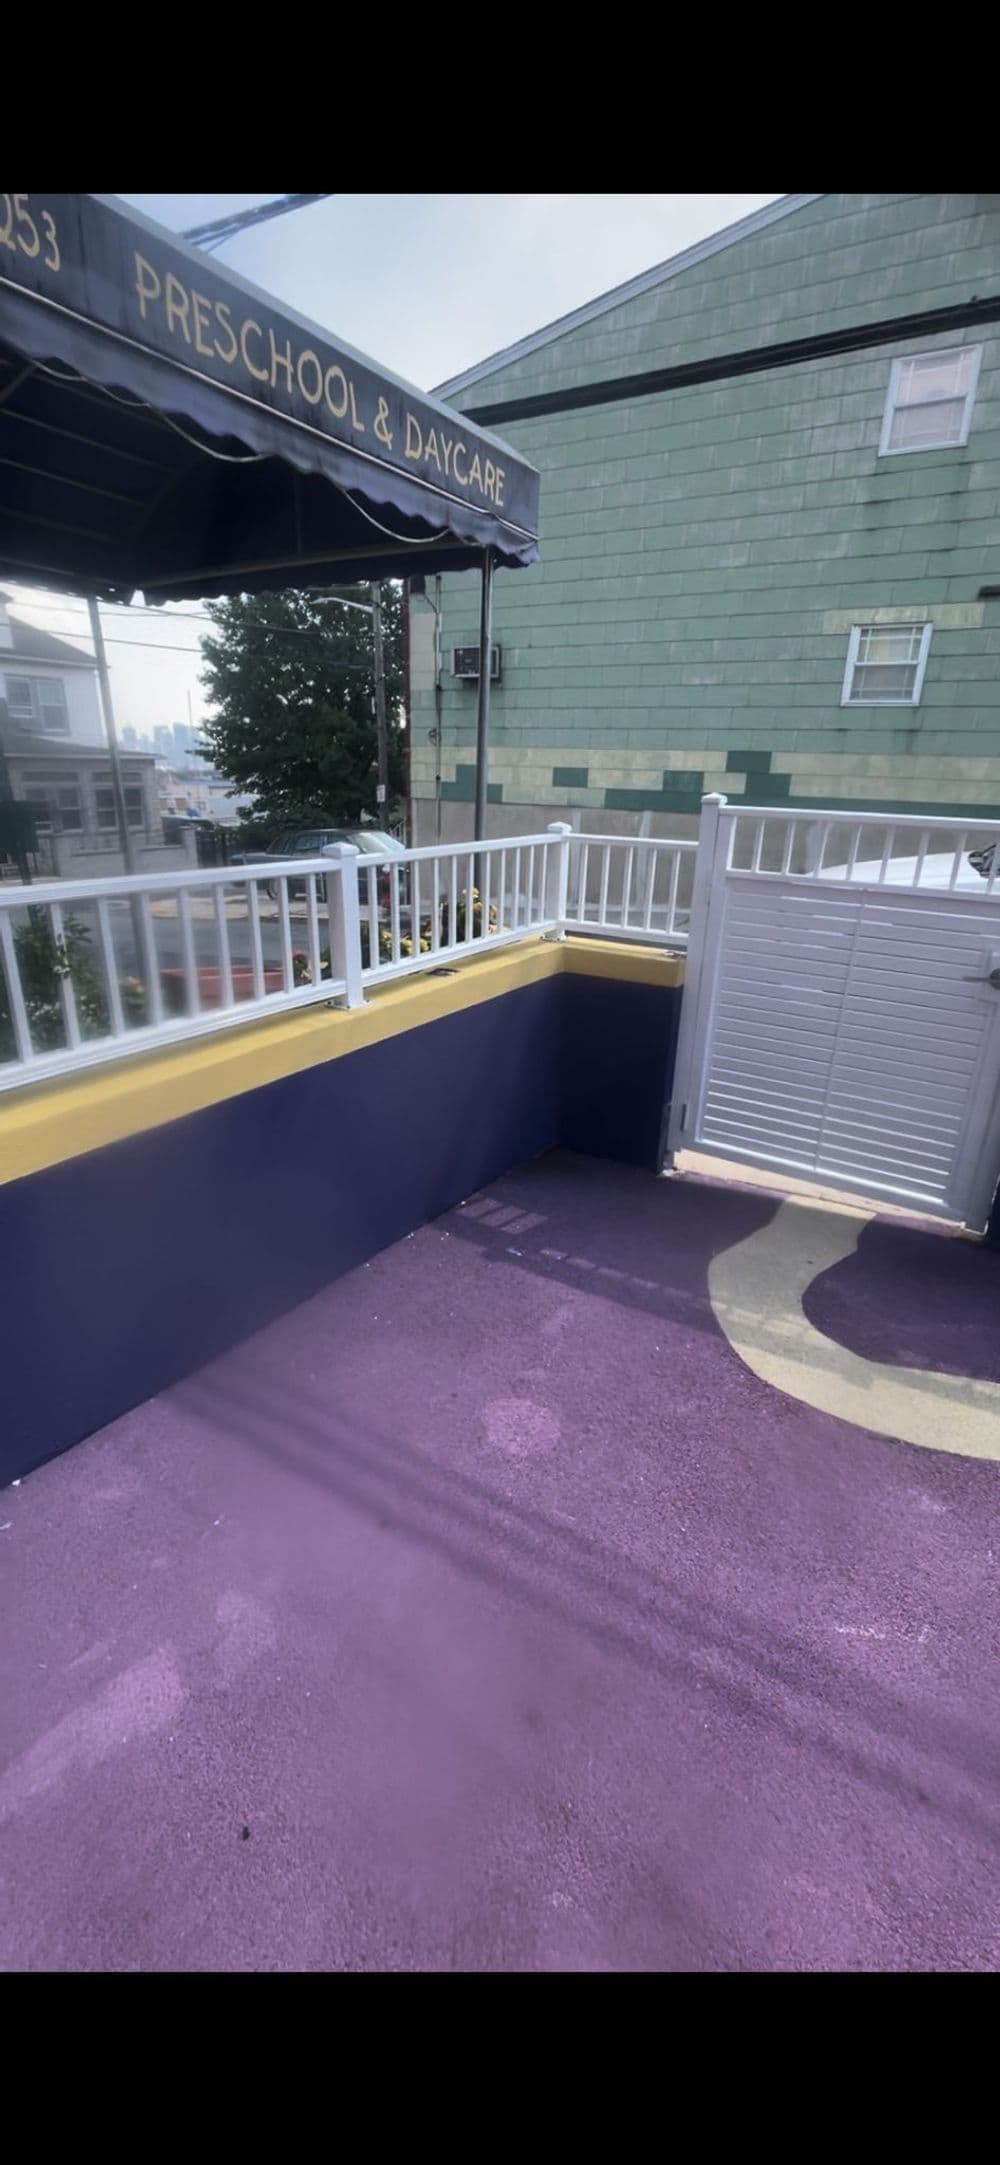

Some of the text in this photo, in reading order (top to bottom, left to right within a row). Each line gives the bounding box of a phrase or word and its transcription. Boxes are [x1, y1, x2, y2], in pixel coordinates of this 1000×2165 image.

[134, 251, 365, 432] PRESCHOOL
[374, 396, 393, 450] &
[404, 412, 506, 507] DAYCARE
